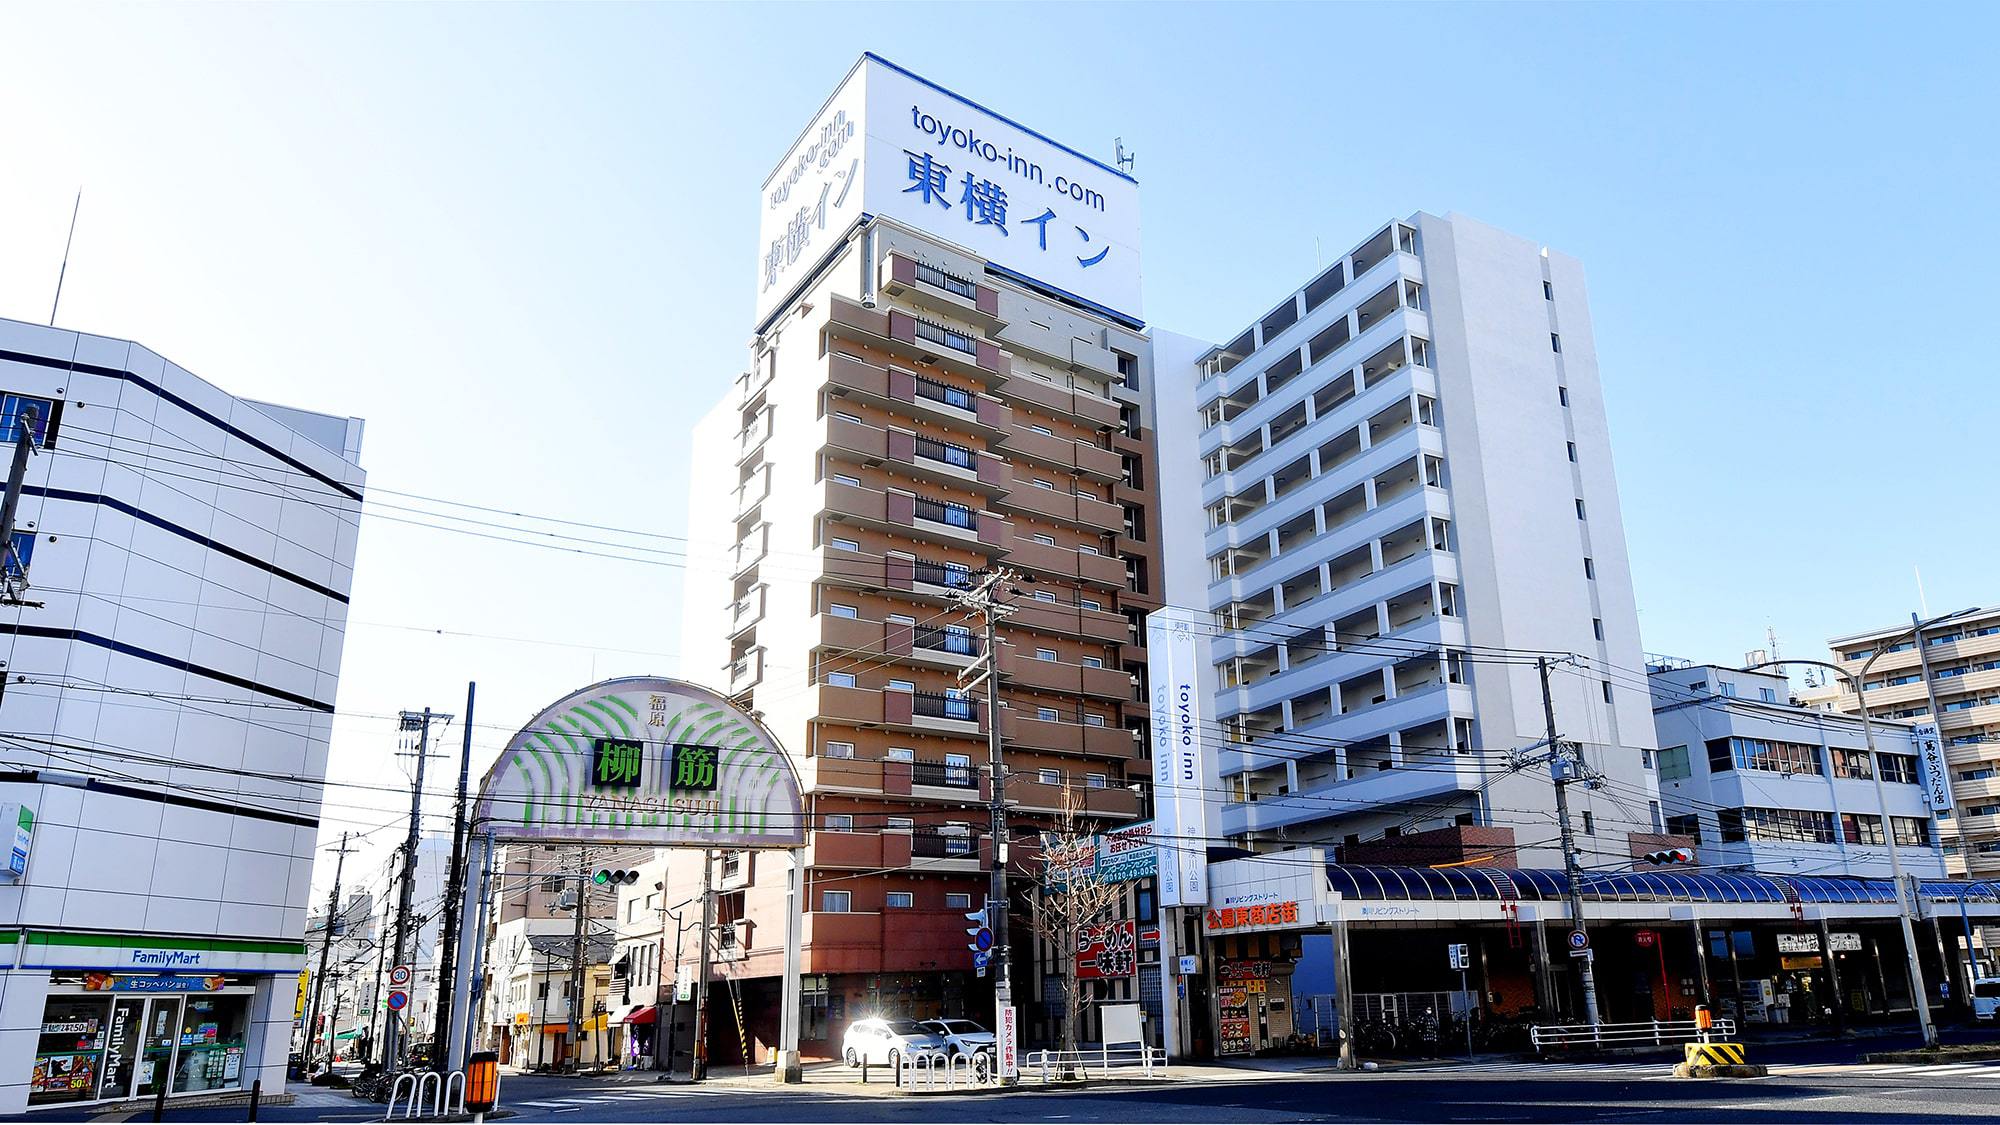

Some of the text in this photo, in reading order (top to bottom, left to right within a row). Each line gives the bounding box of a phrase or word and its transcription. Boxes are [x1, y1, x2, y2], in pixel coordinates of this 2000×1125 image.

[770, 110, 846, 210] toyoko-inn
[912, 104, 1105, 212] toyoko-inn.com
[763, 158, 859, 294] 東横イン
[902, 148, 1109, 269] 東横イン
[648, 694, 667, 727] 福原
[1156, 684, 1170, 782] toyoko inn
[1178, 684, 1195, 780] toyoko inn
[597, 741, 717, 787] 柳筋
[1207, 901, 1299, 930] 公園東商店街
[132, 950, 201, 967] FamilyMart
[395, 971, 405, 980] 30
[1080, 949, 1133, 975] 一味軒
[104, 1007, 129, 1089] FamilyMart
